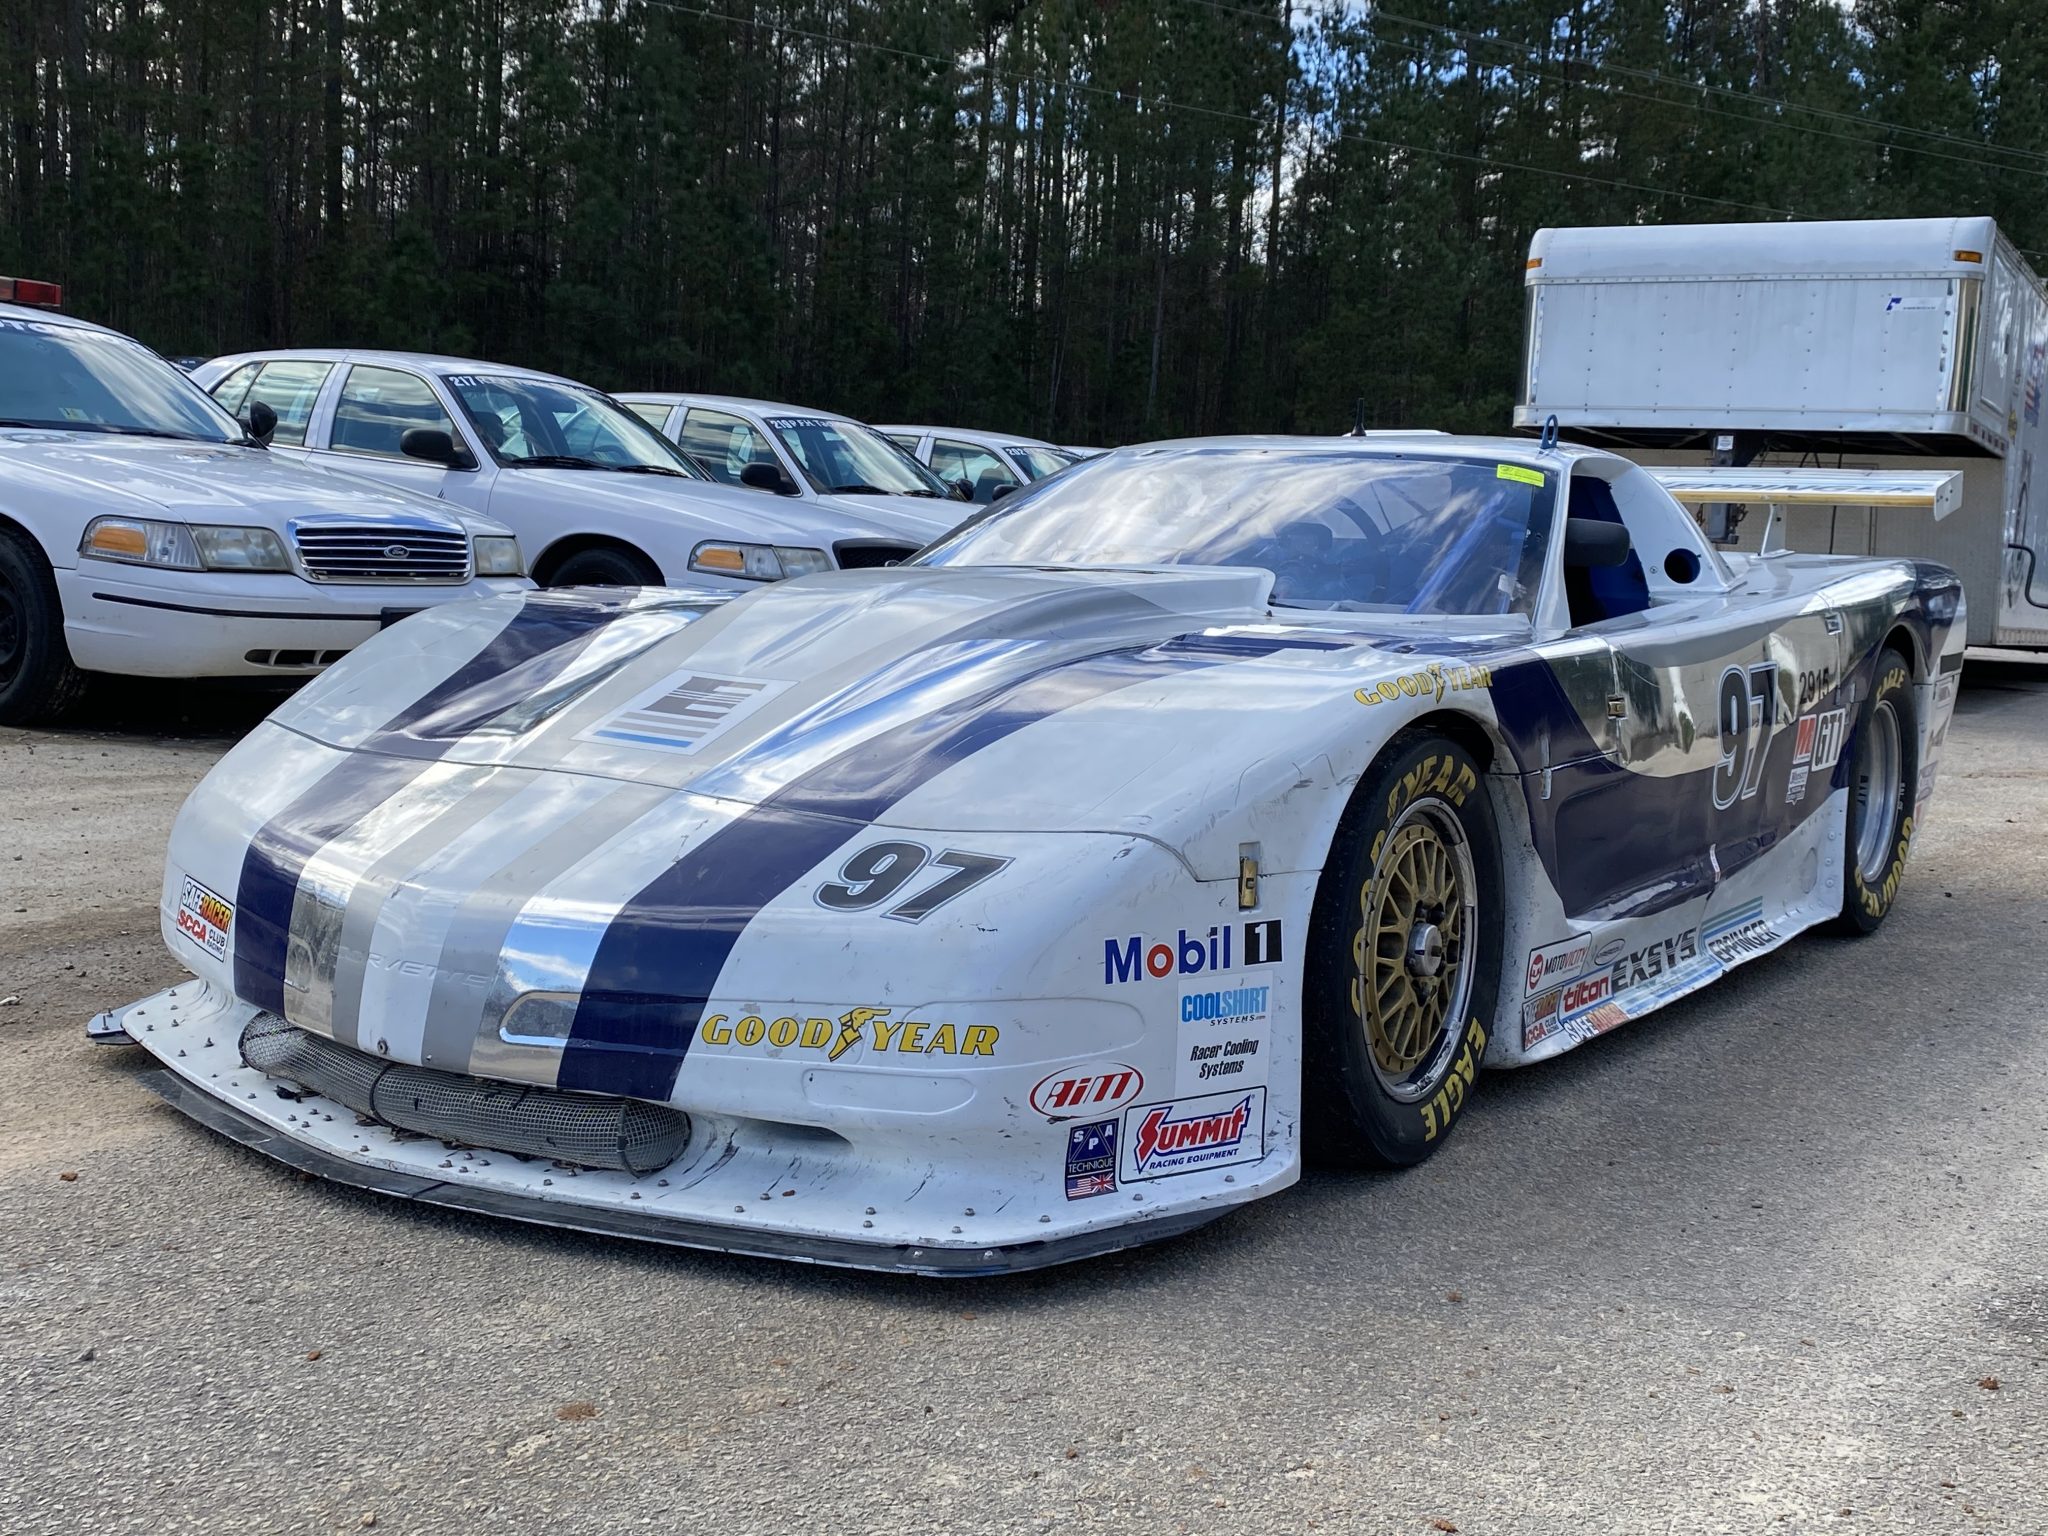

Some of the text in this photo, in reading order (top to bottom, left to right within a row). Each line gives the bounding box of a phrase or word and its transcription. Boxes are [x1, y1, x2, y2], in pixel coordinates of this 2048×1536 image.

[448, 375, 477, 387] 217
[1799, 667, 1830, 704] 2915
[1712, 660, 1778, 810] 97
[813, 839, 1016, 925] 97
[178, 908, 207, 943] SCCA
[208, 928, 226, 947] CLUB
[1104, 925, 1231, 985] Mobil
[1611, 927, 1698, 993] EXSYS
[1181, 985, 1270, 1023] COOLSHIRT
[1563, 975, 1610, 1013] tilton
[1190, 1039, 1259, 1061] Racer Cooling
[1198, 1060, 1245, 1080] Systems
[1420, 1017, 1486, 1143] EAGLE
[1067, 1156, 1114, 1174] TECHNIQUE
[1149, 1148, 1240, 1170] RACING EQUIPMENT
